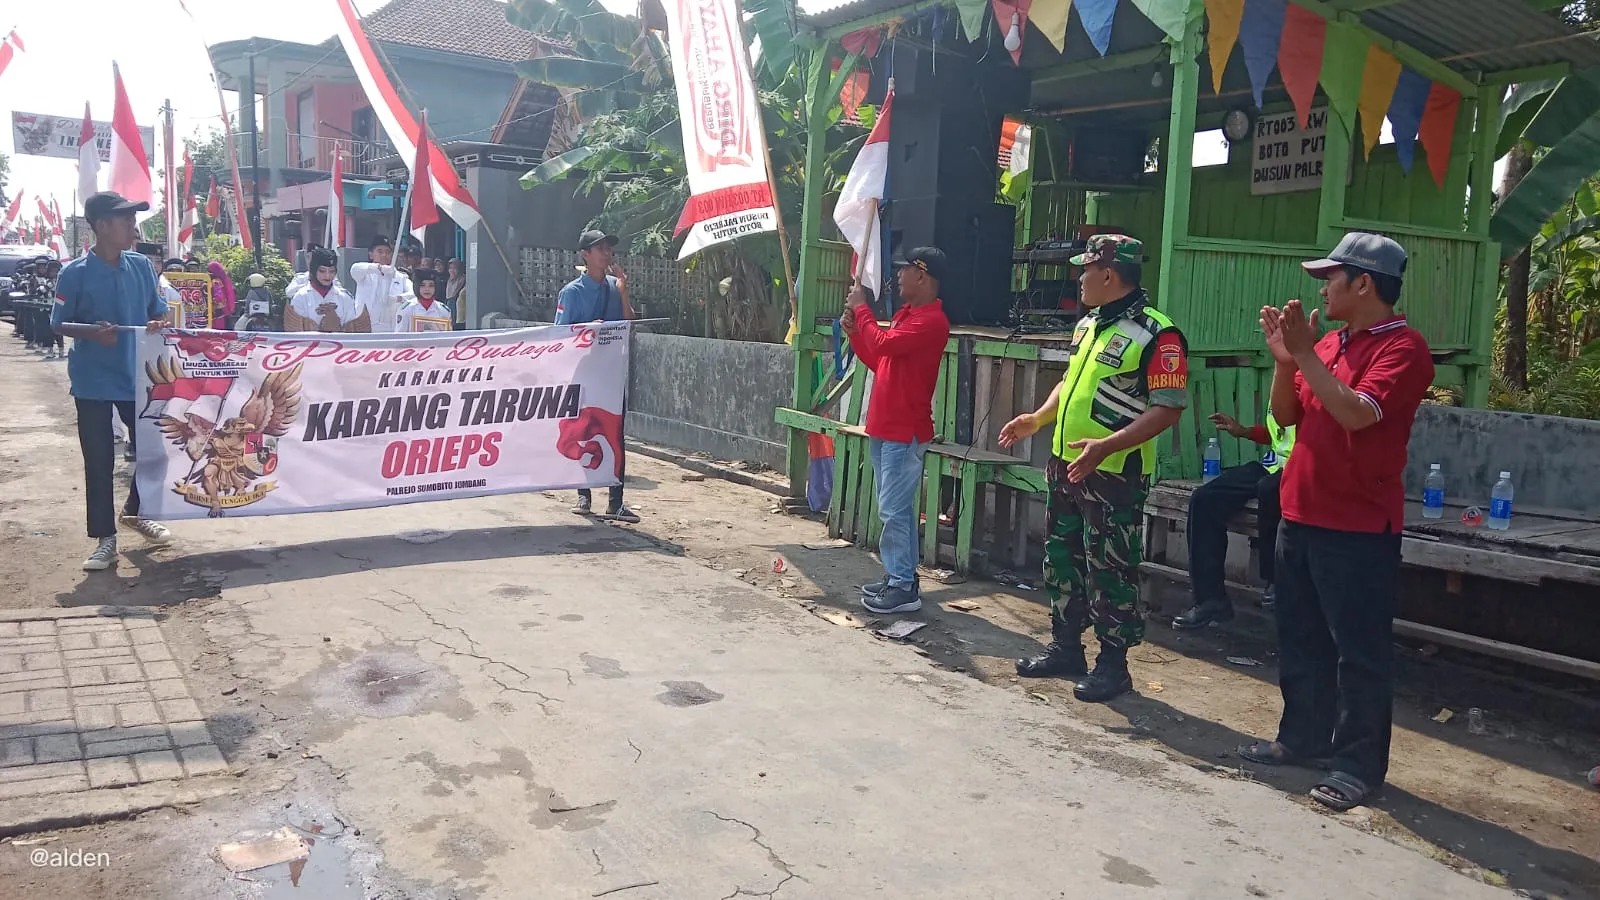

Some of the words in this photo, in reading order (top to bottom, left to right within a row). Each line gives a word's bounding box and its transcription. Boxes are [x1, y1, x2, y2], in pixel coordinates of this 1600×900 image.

[1259, 141, 1288, 160] BOTO
[1301, 135, 1326, 155] PUT
[1253, 164, 1291, 183] DUSUN
[1294, 160, 1323, 179] PALR
[262, 339, 435, 371] Pawai
[445, 336, 565, 361] Budaya
[378, 365, 494, 388] KARNAVAL
[302, 392, 451, 442] KARANG
[458, 382, 581, 427] TARUNA
[381, 431, 502, 479] ORIEPS
[386, 485, 416, 496] PALREJO
[417, 481, 453, 492] SUMOBITO
